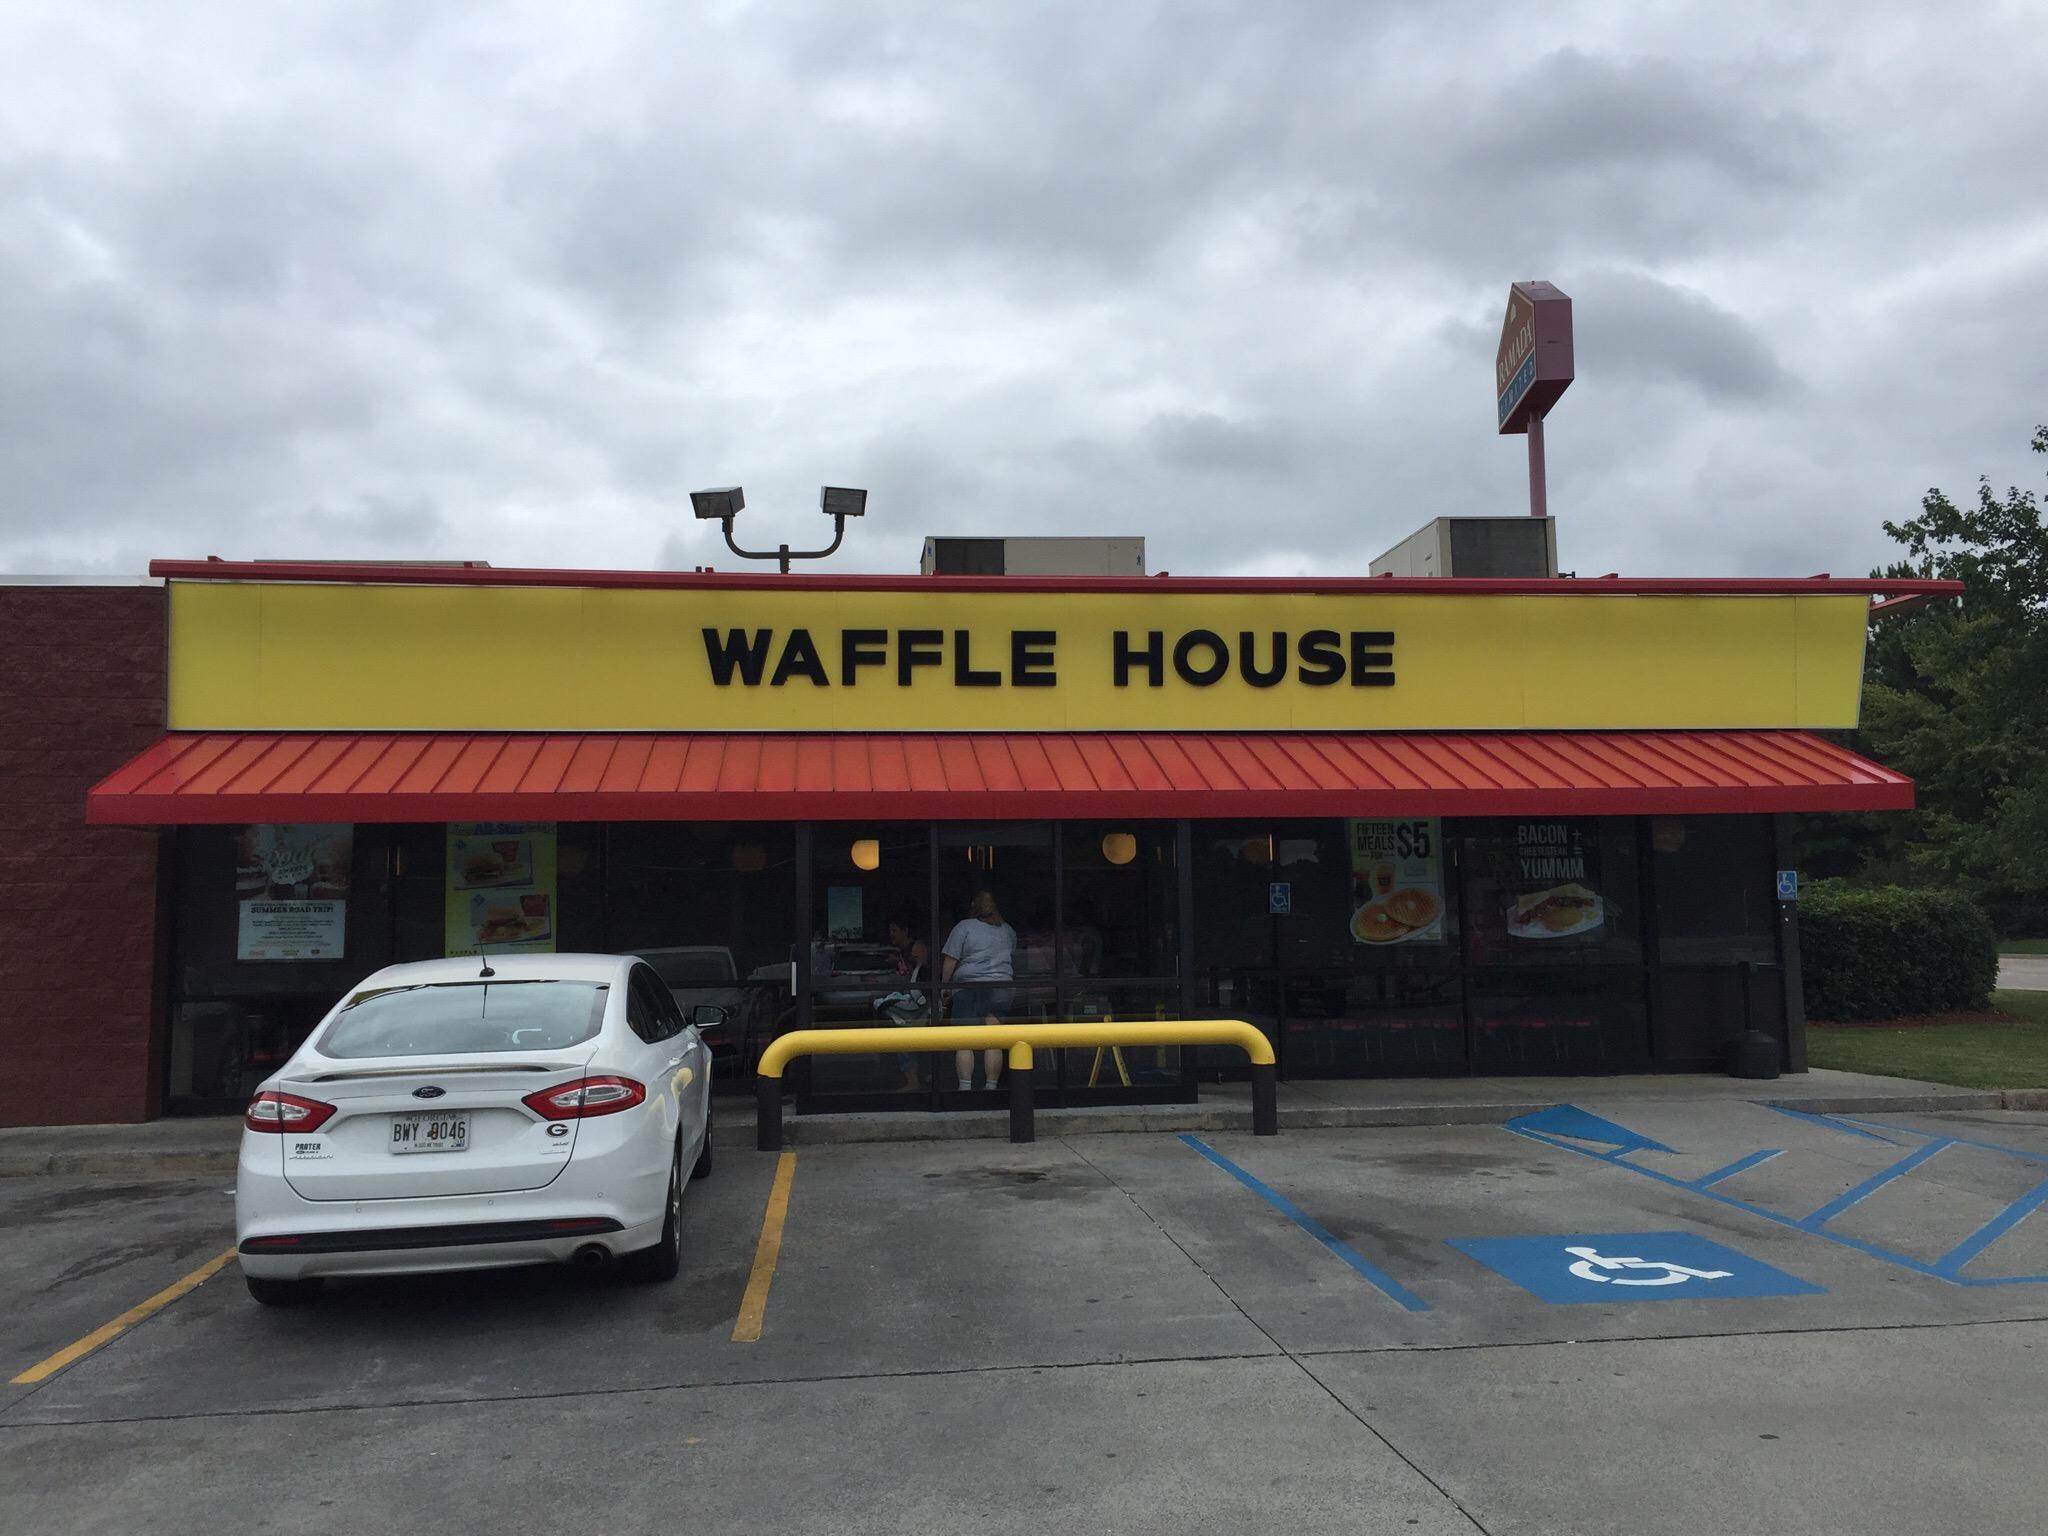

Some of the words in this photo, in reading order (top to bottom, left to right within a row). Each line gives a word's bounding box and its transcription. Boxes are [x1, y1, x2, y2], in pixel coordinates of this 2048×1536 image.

[1498, 319, 1533, 388] RAMADA
[701, 628, 1058, 687] WAFFLE
[1112, 629, 1395, 688] HOUSE
[1357, 822, 1394, 835] FIFTEEN
[1518, 824, 1568, 844] BACON
[1357, 836, 1394, 850] MEALS
[1397, 821, 1430, 859] $5
[1520, 857, 1584, 880] YUMMM
[251, 906, 288, 914] SUMMER
[289, 906, 311, 914] ROAD
[393, 1123, 419, 1142] BWY
[547, 1123, 569, 1137] G
